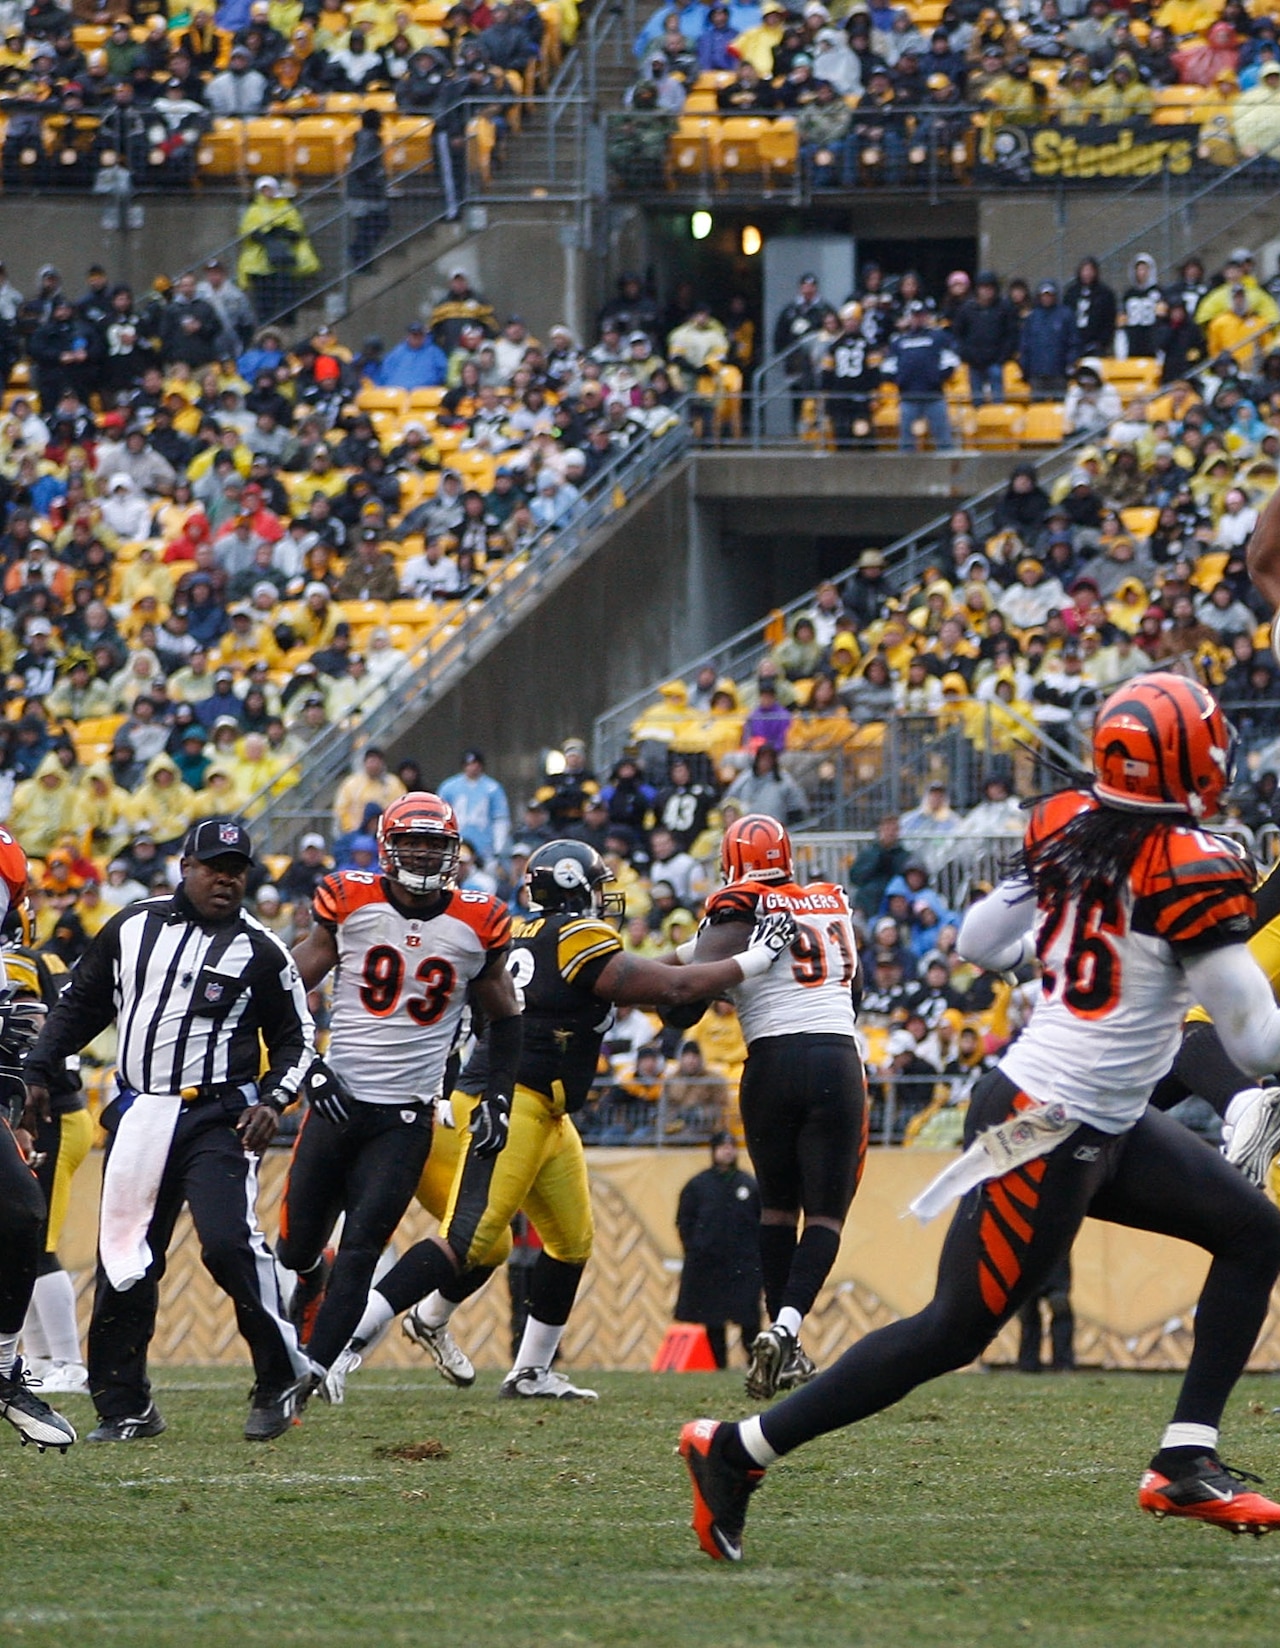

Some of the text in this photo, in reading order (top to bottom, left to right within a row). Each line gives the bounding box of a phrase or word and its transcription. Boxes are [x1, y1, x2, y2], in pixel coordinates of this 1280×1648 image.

[1032, 129, 1192, 178] Steelers
[662, 794, 698, 832] 43
[790, 919, 850, 988] 91
[359, 945, 457, 1026] 93
